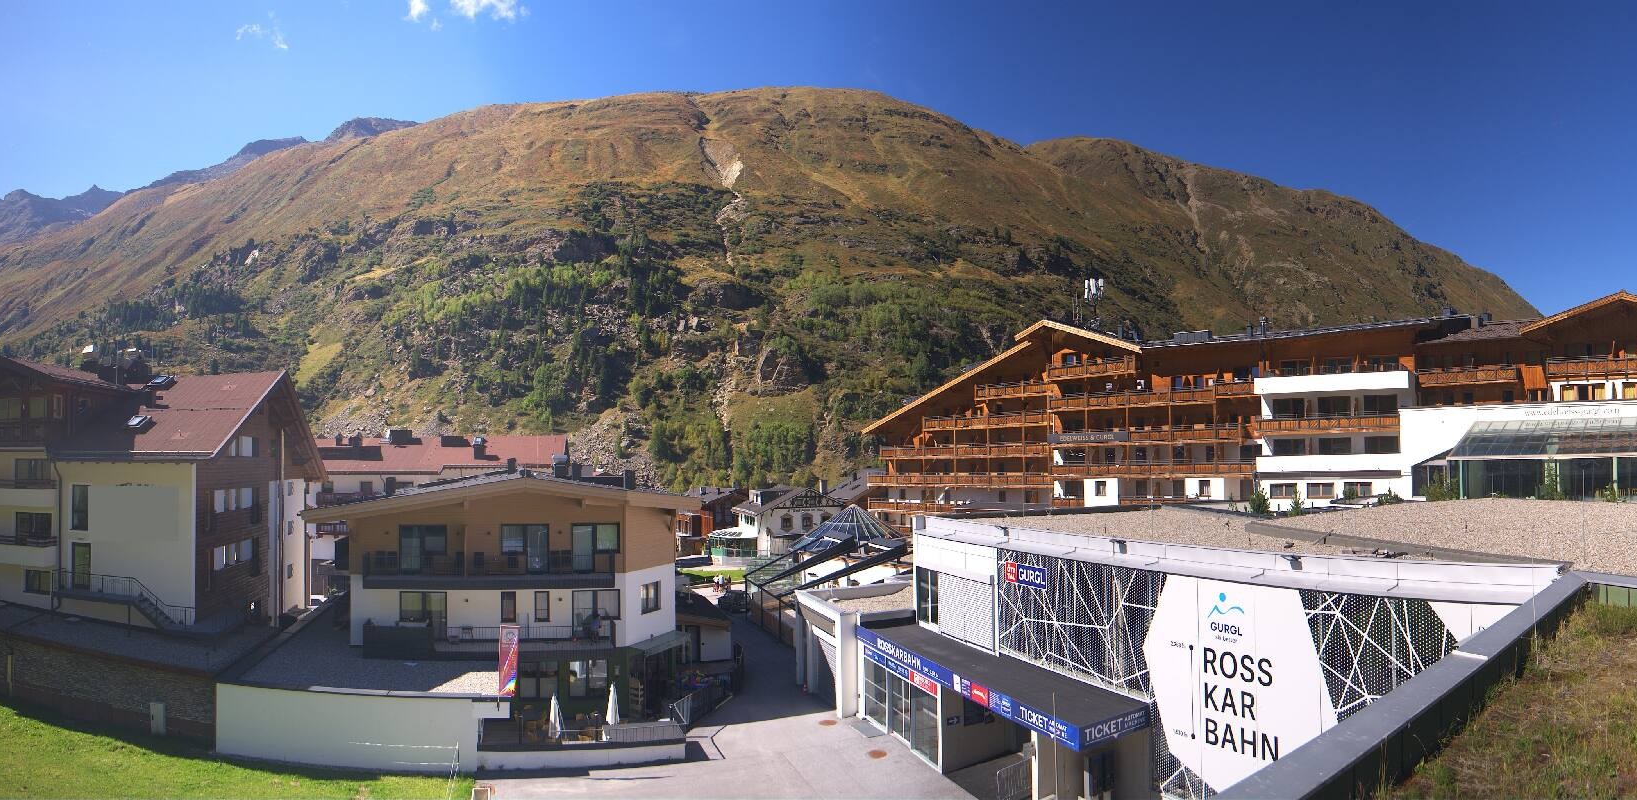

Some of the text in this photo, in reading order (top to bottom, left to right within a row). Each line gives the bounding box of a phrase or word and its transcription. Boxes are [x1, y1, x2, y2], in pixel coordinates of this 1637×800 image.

[1019, 567, 1046, 586] GURGL
[1210, 621, 1243, 637] GURGL
[877, 637, 922, 671] ROSSKARBAHN
[1203, 647, 1273, 687] ROSS
[1204, 682, 1256, 721] KAR
[1019, 705, 1049, 730] TICKET
[1084, 717, 1124, 741] TICKET
[1205, 717, 1279, 762] BAHN
